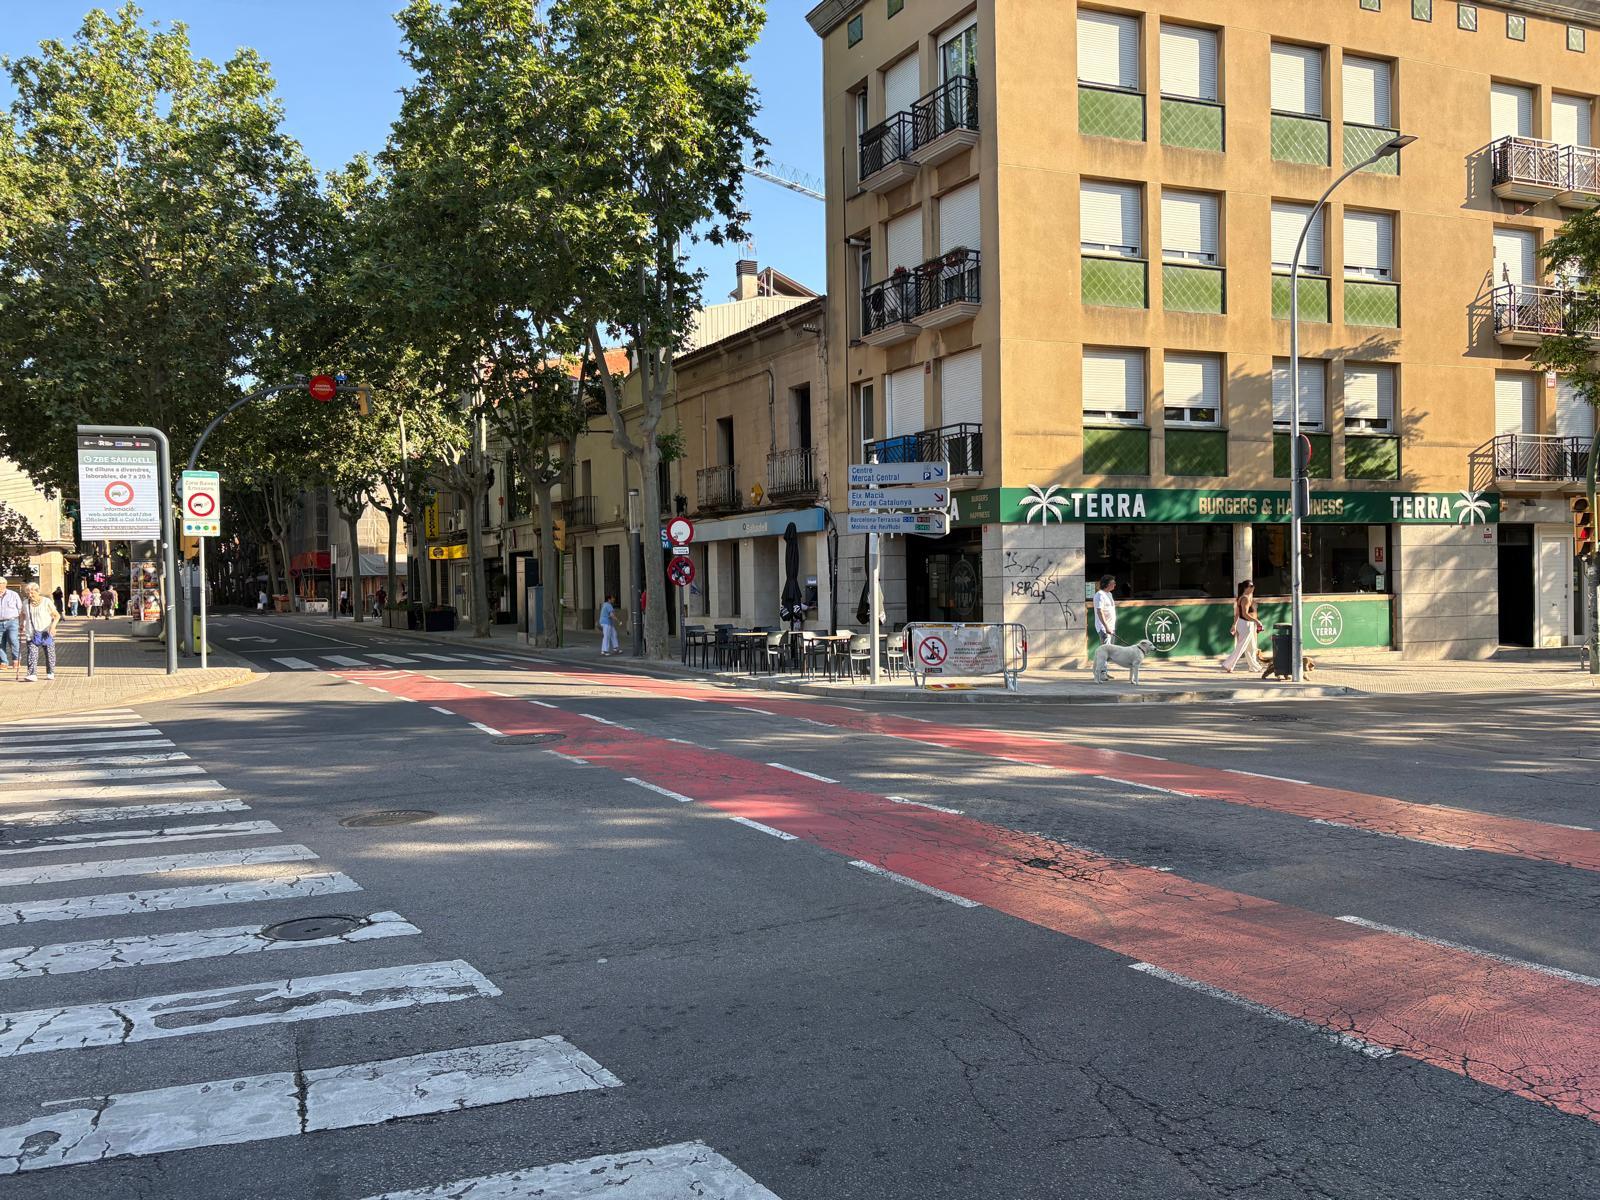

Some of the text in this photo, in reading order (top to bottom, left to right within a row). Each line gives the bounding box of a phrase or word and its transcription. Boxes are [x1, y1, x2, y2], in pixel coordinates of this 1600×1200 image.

[1071, 493, 1146, 517] TERRA
[1200, 498, 1344, 515] BURGERS & HAINESS
[1390, 497, 1451, 518] TERRA
[1152, 633, 1176, 642] TERRA
[1316, 628, 1337, 636] TERRA
